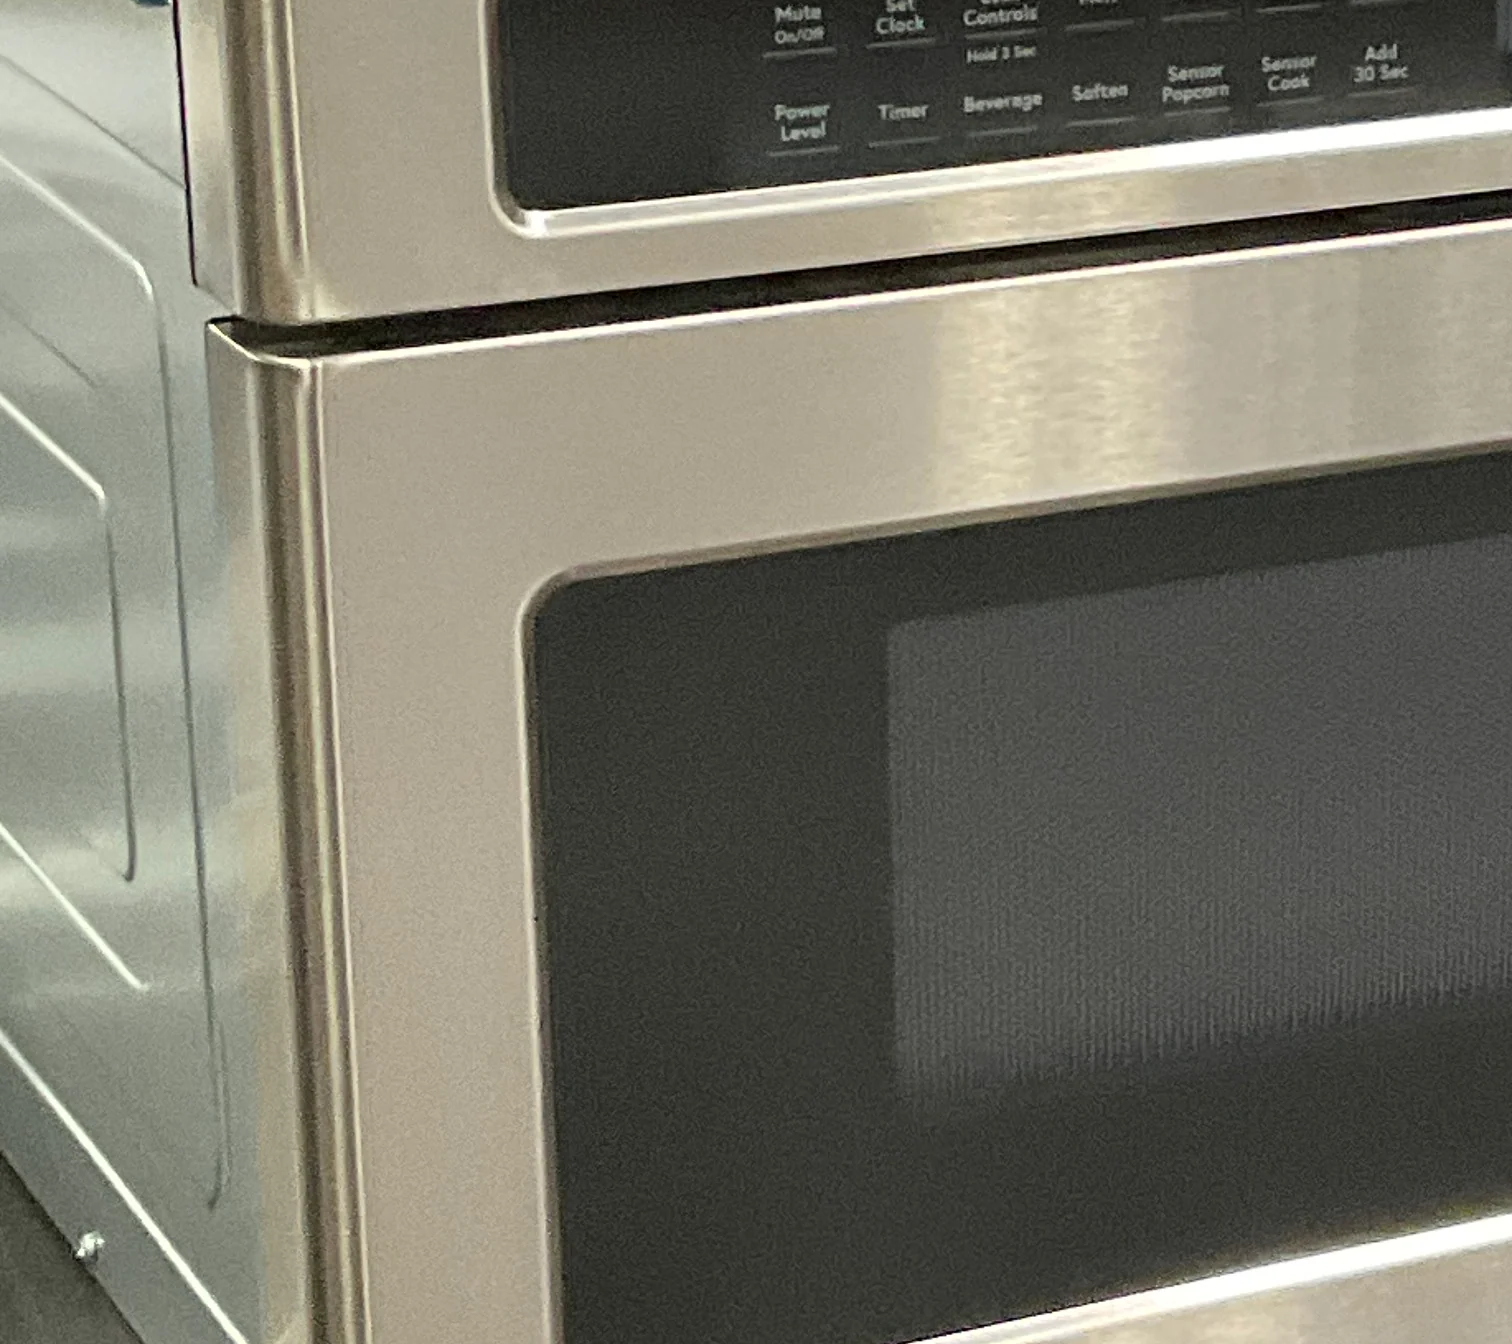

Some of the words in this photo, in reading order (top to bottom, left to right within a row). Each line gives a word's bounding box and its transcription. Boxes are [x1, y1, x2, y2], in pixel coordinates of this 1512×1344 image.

[774, 5, 822, 23] Mute
[963, 5, 1038, 26] Controls
[774, 25, 825, 45] On/Off
[875, 16, 926, 35] Clock
[1365, 43, 1398, 61] Add
[1167, 65, 1224, 82] Sensor
[1261, 56, 1317, 72] Sensor
[1353, 65, 1375, 83] 30
[1380, 63, 1409, 80] Sec
[1072, 83, 1128, 102] Soften
[1268, 74, 1310, 92] Cook
[963, 92, 1043, 114] Beverage
[1162, 84, 1230, 104] Popcorn
[774, 104, 830, 120] Power
[878, 104, 929, 120] Timer
[780, 120, 826, 142] Level
